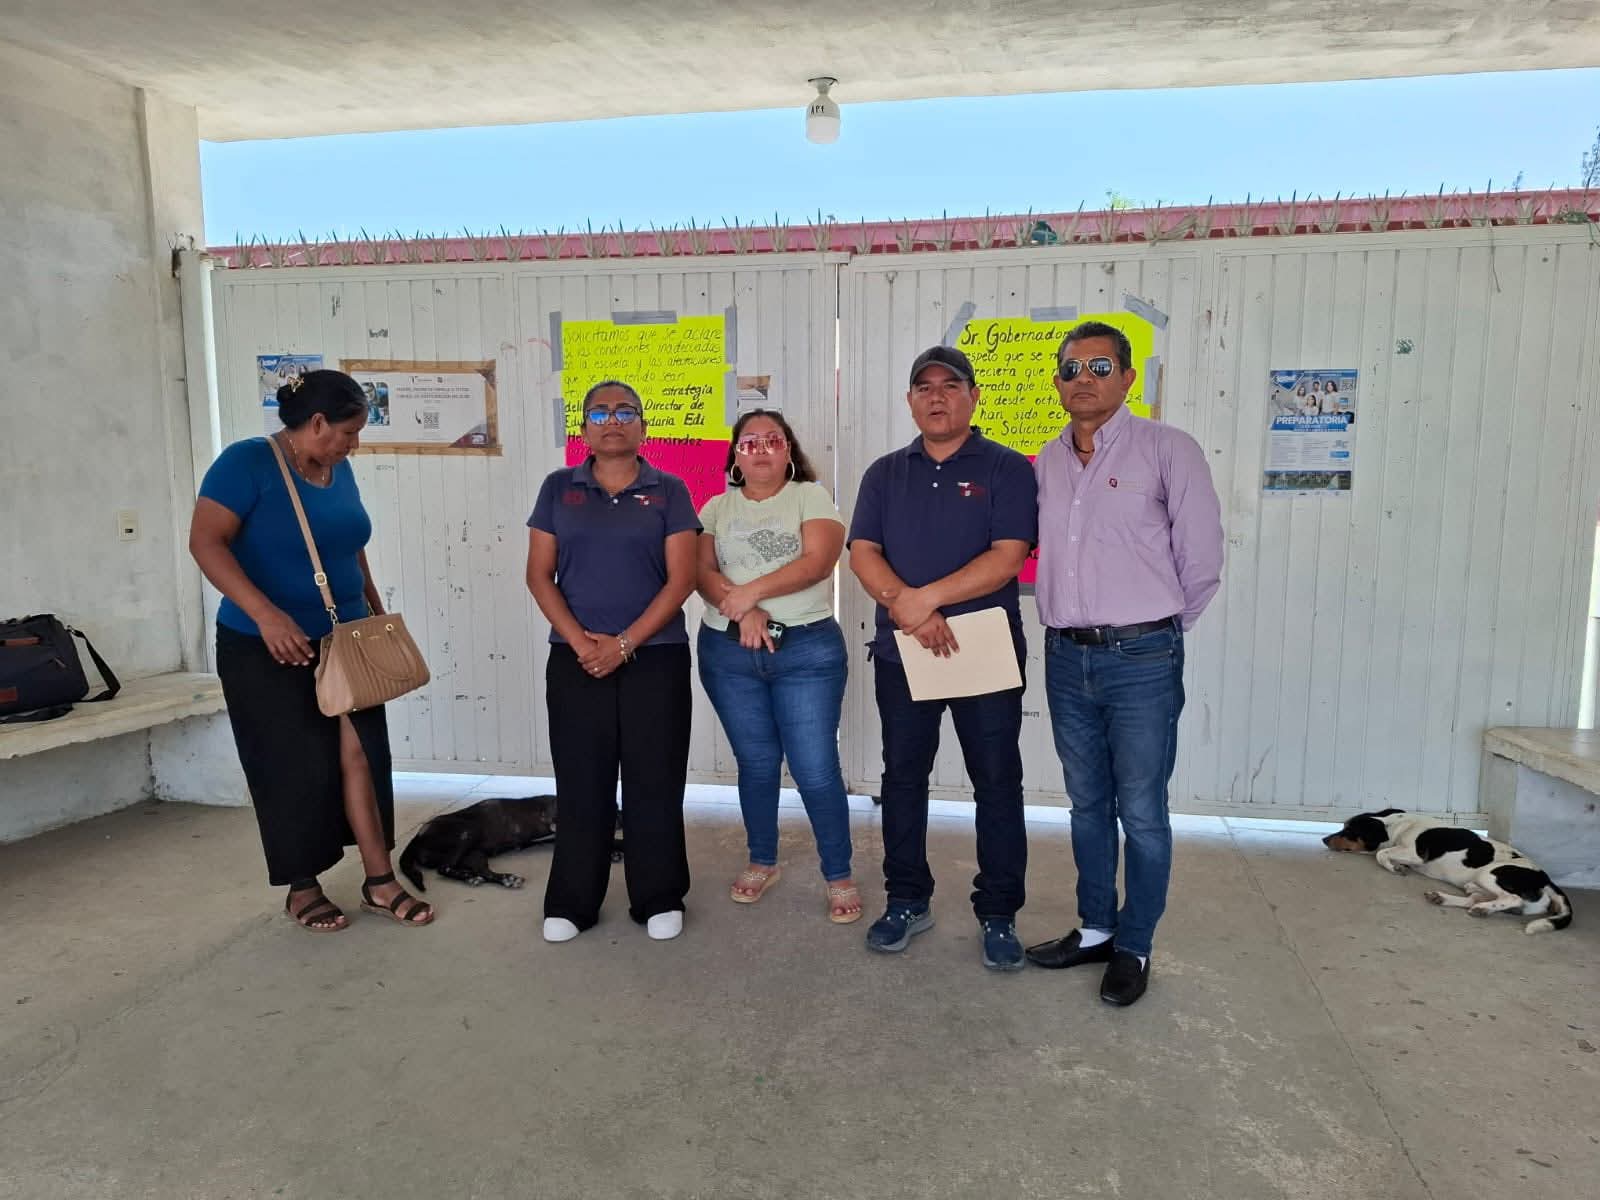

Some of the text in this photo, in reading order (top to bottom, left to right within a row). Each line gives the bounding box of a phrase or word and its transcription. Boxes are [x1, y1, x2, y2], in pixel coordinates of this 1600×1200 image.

[682, 327, 721, 341] aclare
[960, 322, 981, 346] Sr.
[593, 356, 630, 370] escuela
[1004, 351, 1025, 367] que
[1030, 350, 1043, 362] se
[624, 369, 656, 382] tenido
[974, 366, 1017, 378] reciera
[1024, 366, 1045, 381] que
[661, 382, 713, 402] estrategia
[977, 379, 1012, 392] erado
[1015, 380, 1036, 397] que
[644, 398, 705, 412] Director de
[993, 393, 1025, 406] desde
[682, 412, 705, 427] Edi
[979, 407, 1004, 421] han
[1013, 407, 1039, 421] sido
[1276, 415, 1347, 425] PREPARATORIA
